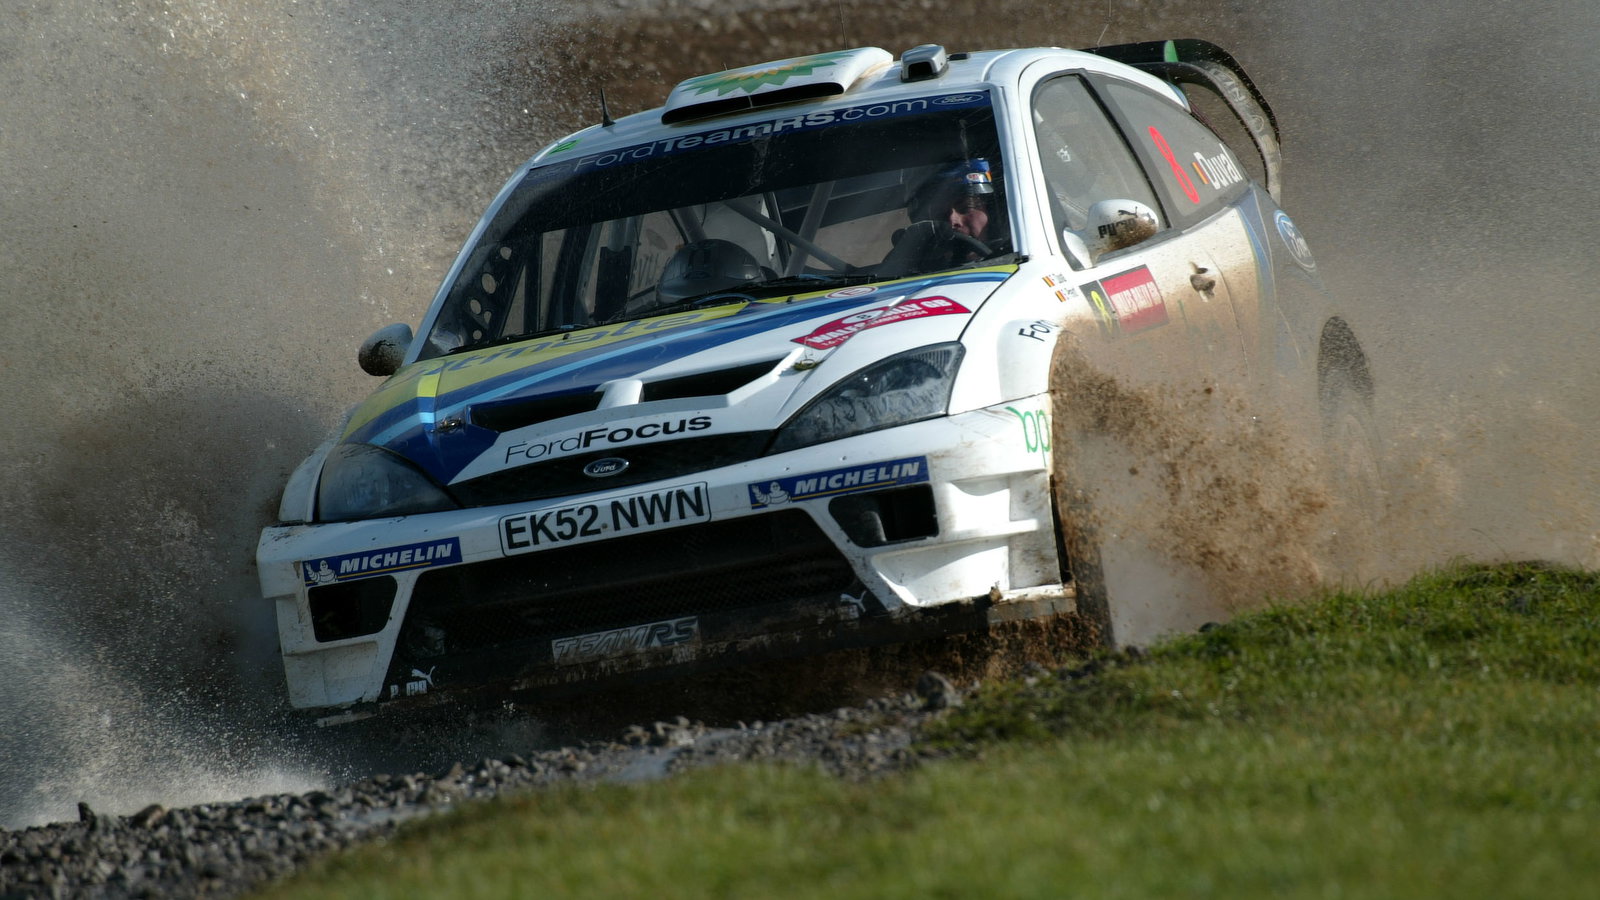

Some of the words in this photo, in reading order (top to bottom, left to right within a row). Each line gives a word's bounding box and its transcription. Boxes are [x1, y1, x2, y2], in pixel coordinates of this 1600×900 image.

[574, 99, 928, 172] FordTeamRS.com
[1148, 126, 1200, 204] 8
[1193, 143, 1243, 189] Duval
[880, 303, 921, 321] ALLY
[921, 299, 953, 309] GB
[505, 416, 712, 464] FordFocus
[1005, 406, 1051, 468] bp
[795, 462, 920, 494] MICHELIN
[505, 505, 601, 549] EK52
[611, 486, 705, 531] NWN
[340, 543, 452, 574] MICHELIN
[390, 680, 428, 698] PMA
